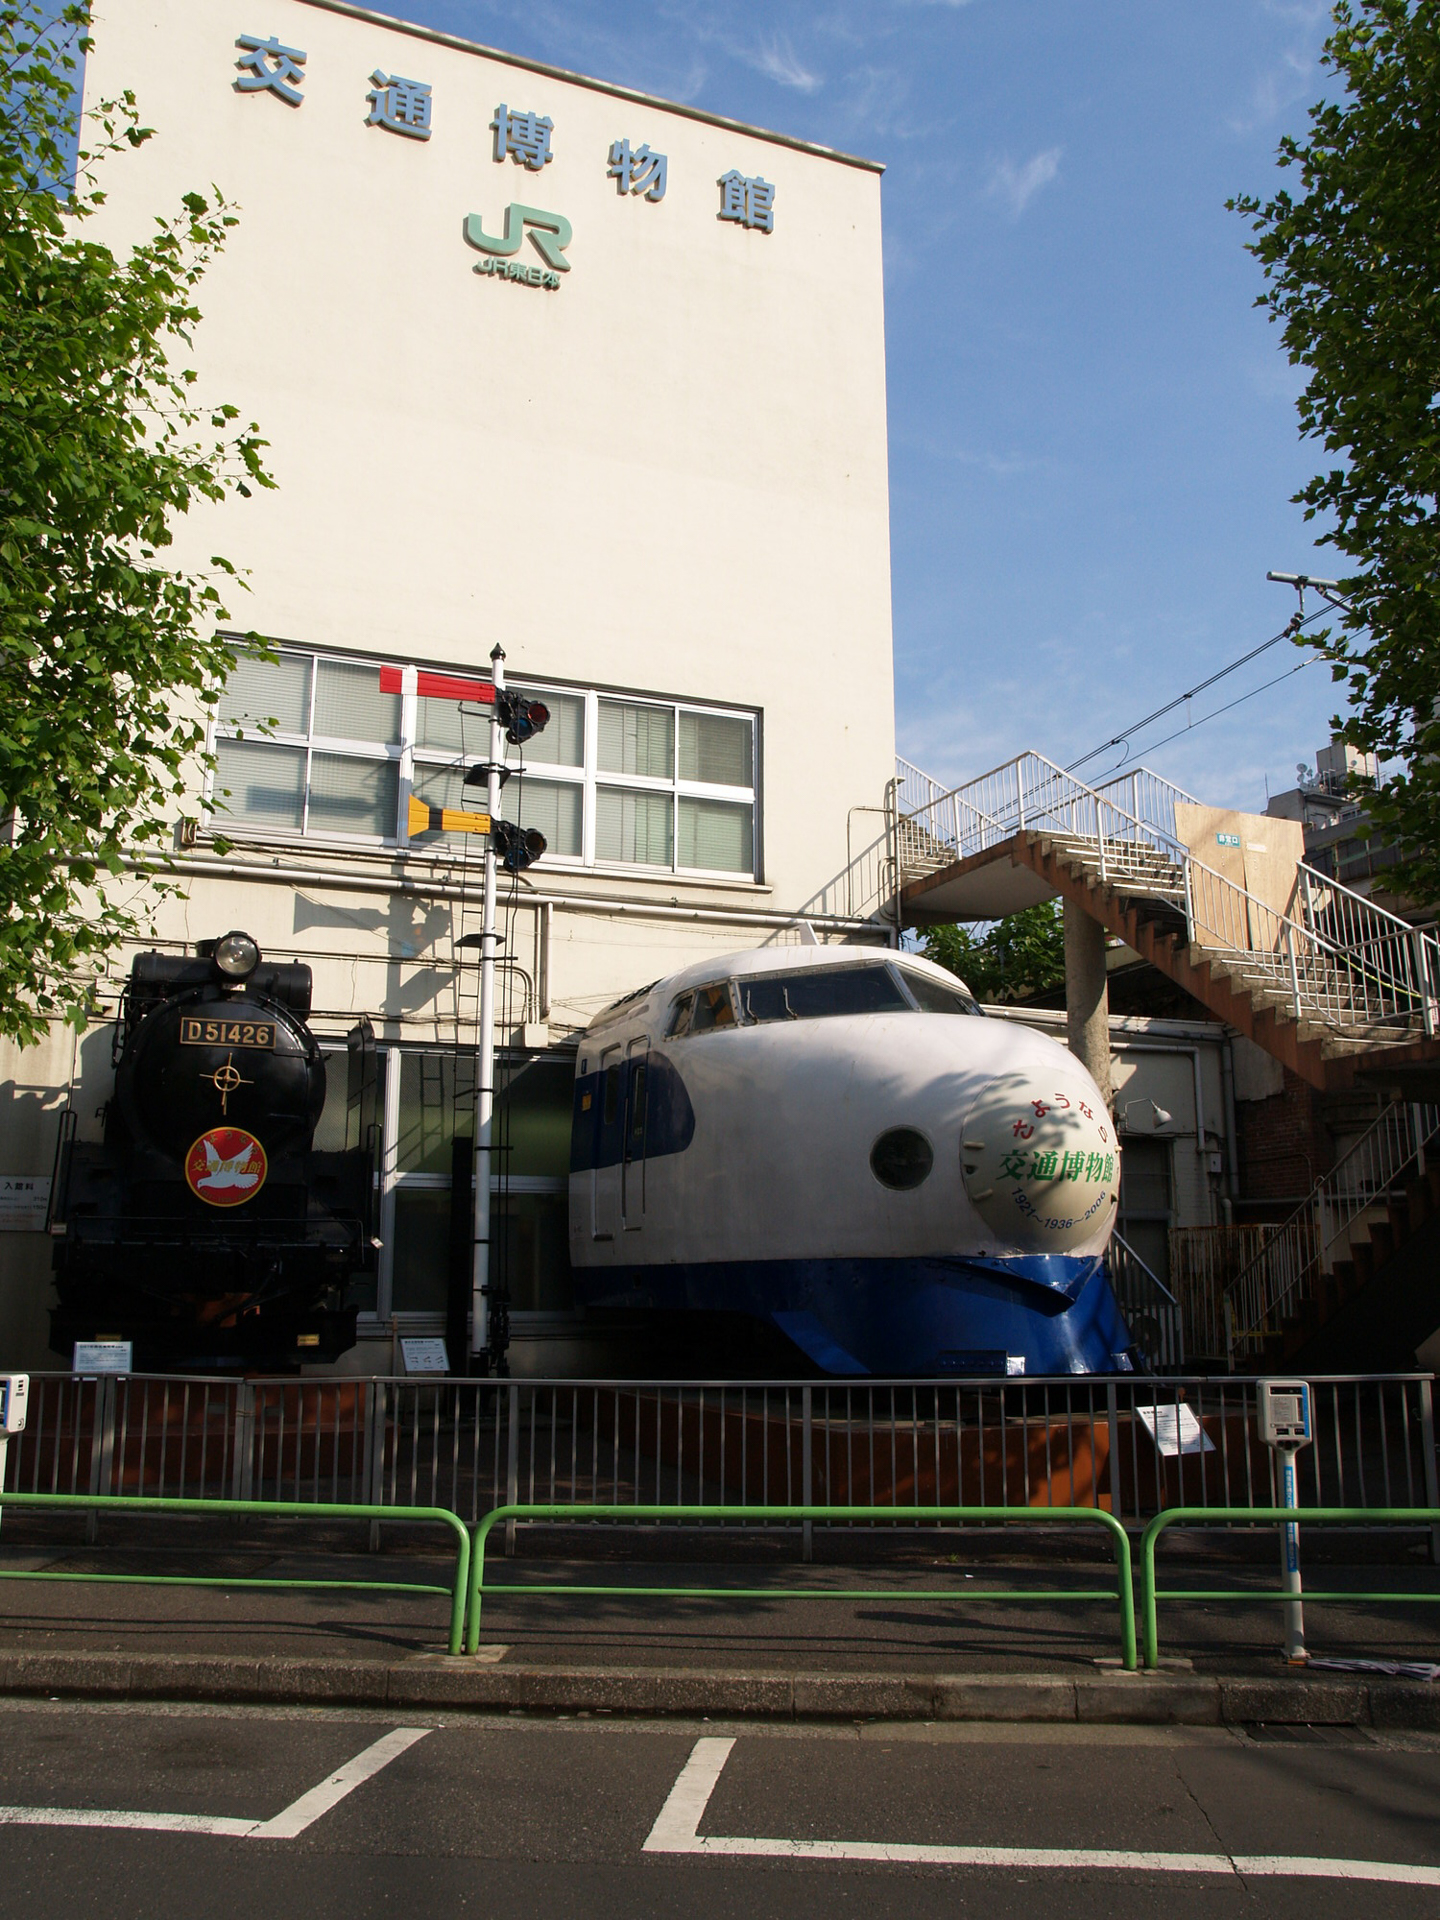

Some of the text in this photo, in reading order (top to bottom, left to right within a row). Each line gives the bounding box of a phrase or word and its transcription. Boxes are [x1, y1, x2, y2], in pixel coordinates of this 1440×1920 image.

[231, 33, 776, 235] 交通博物館
[462, 203, 573, 271] JR
[472, 257, 562, 292] JR東日本
[188, 1021, 270, 1045] D51426
[192, 1158, 263, 1174] 交通博物館
[996, 1149, 1115, 1183] 交通博物館
